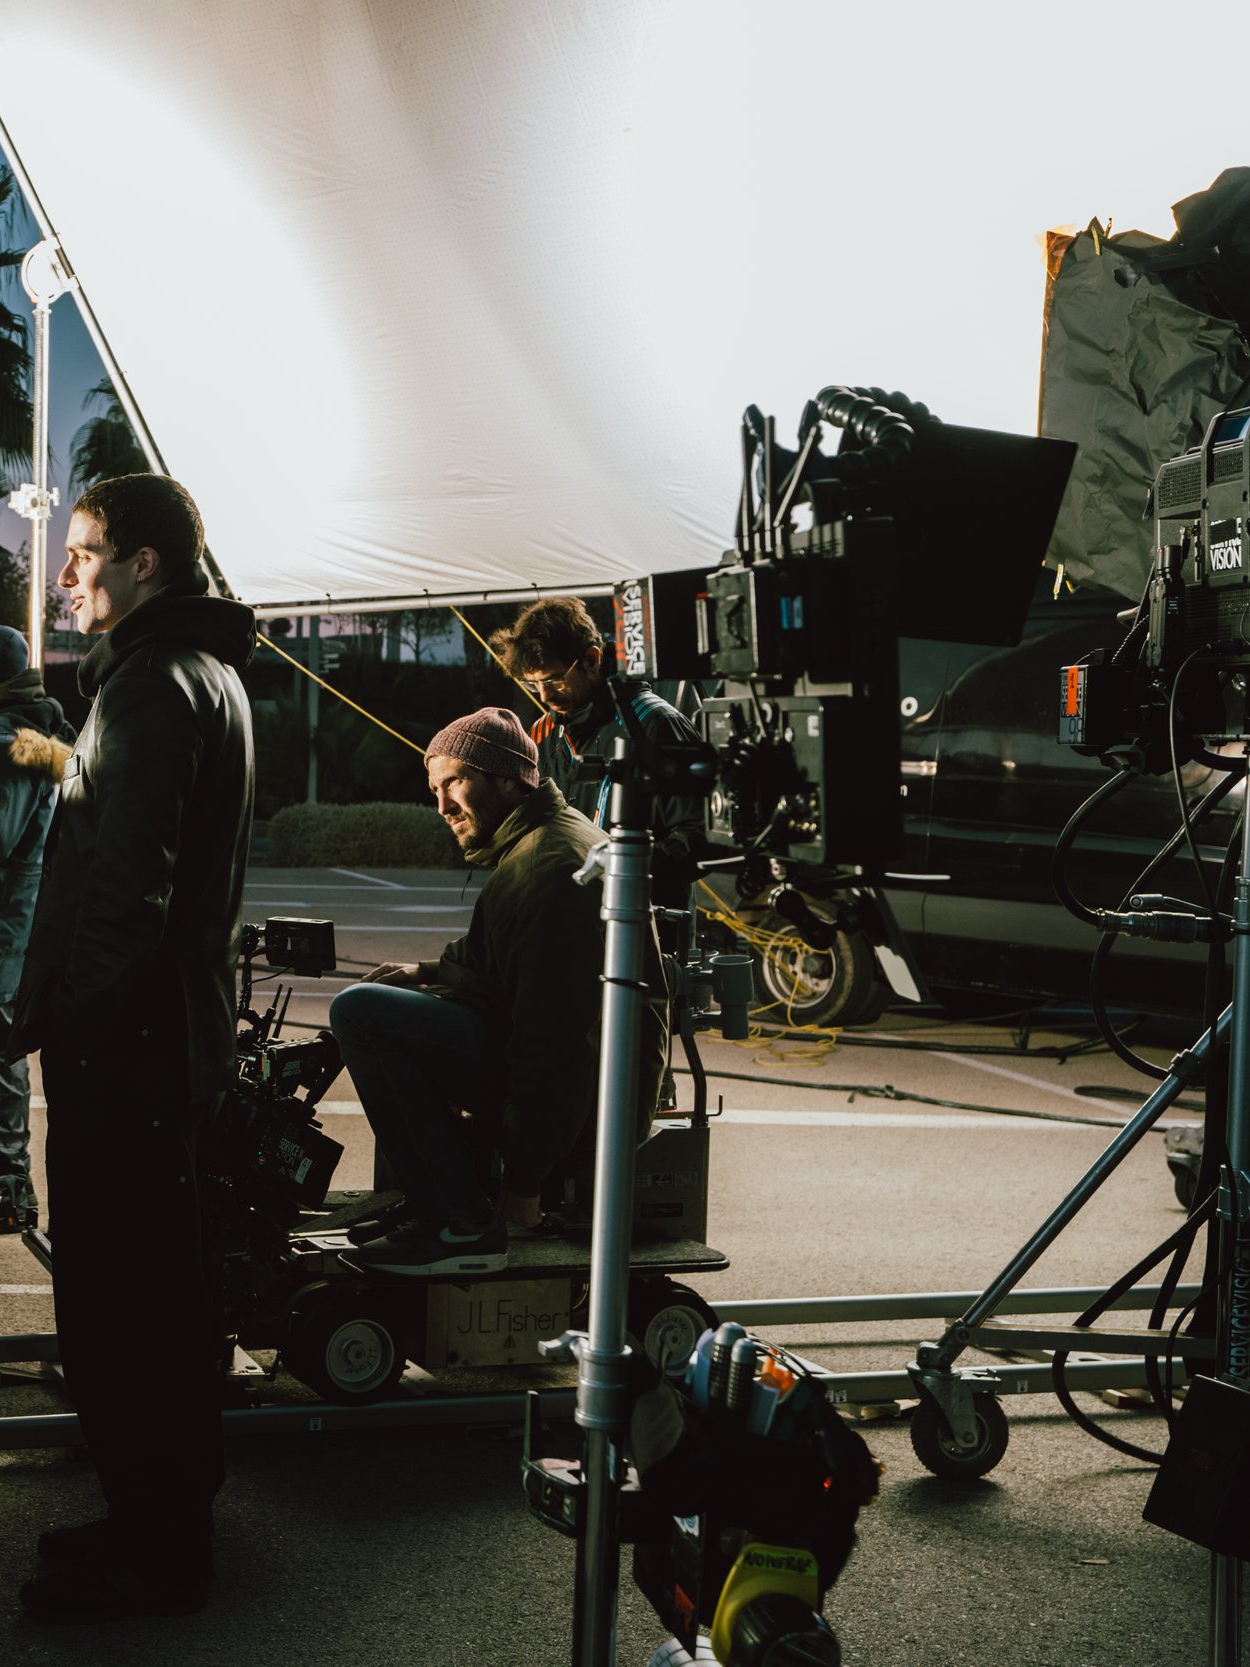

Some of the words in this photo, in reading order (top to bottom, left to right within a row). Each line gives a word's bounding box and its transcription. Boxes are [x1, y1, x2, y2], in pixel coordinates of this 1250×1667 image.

[1210, 545, 1242, 571] VISION
[629, 585, 646, 675] SERVICE
[457, 1299, 562, 1335] J.L.Fisher
